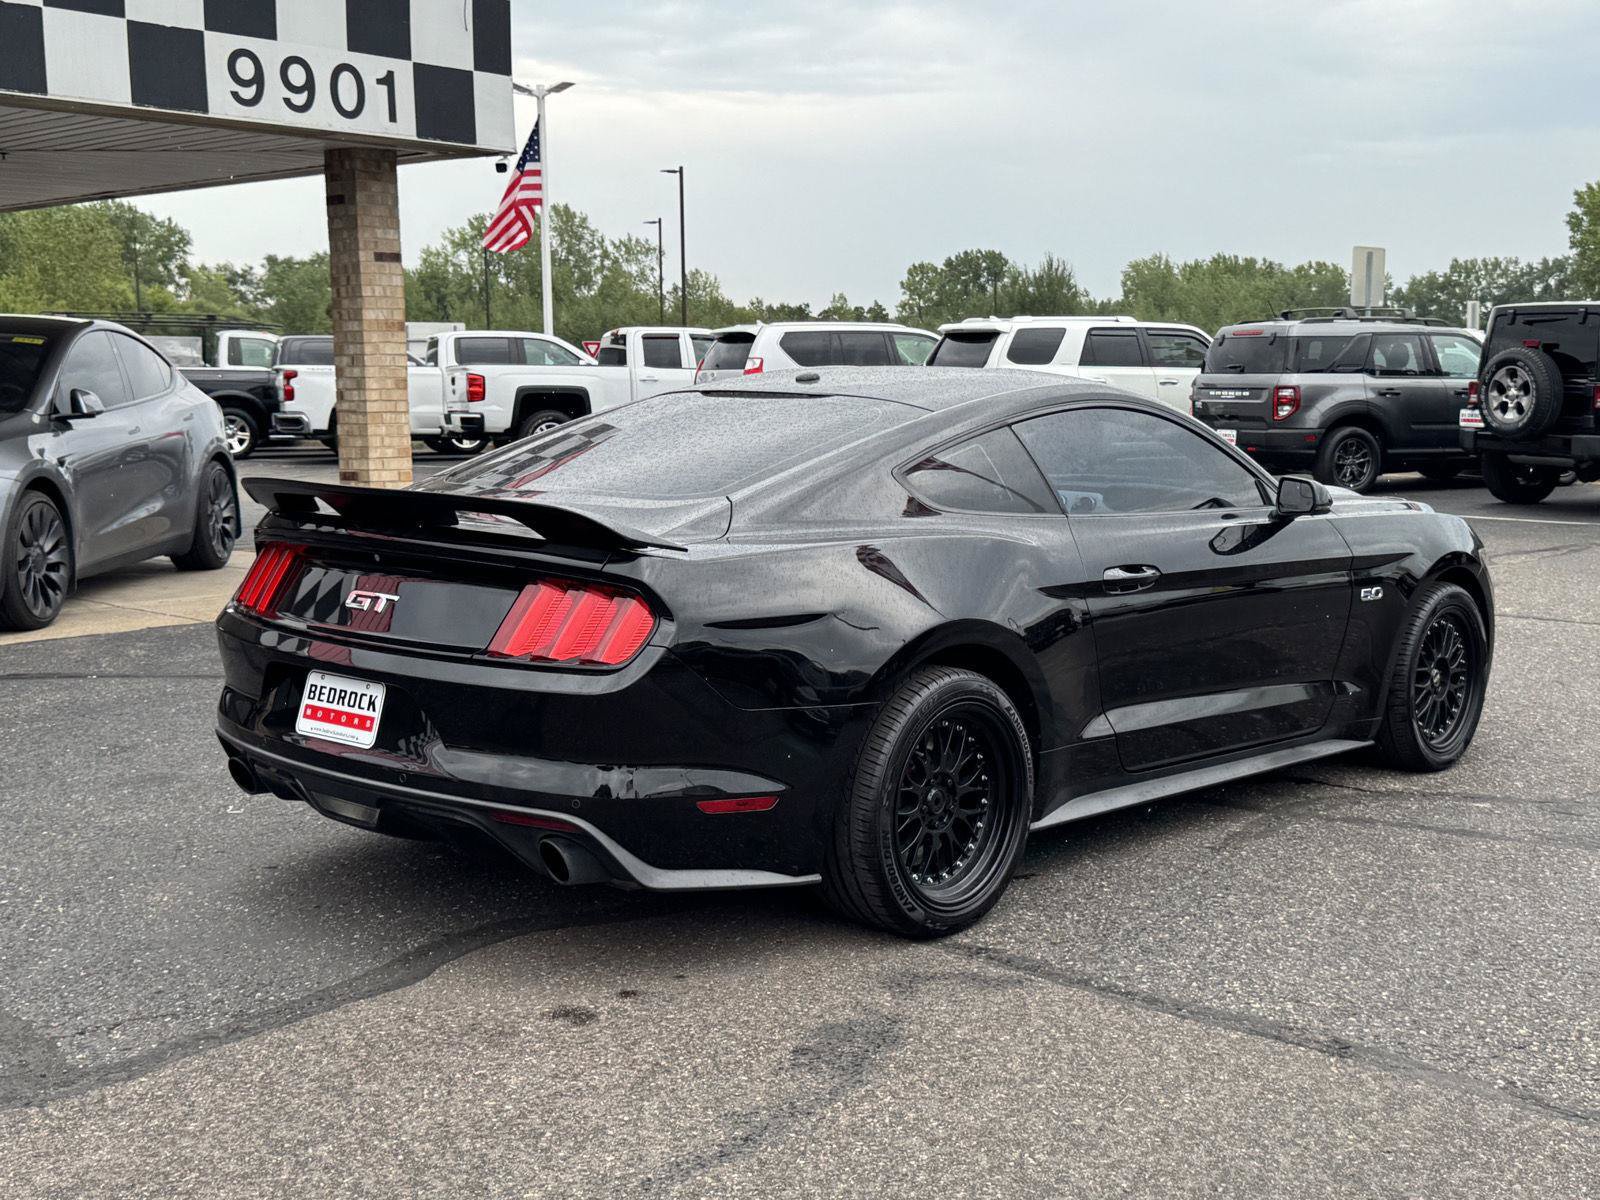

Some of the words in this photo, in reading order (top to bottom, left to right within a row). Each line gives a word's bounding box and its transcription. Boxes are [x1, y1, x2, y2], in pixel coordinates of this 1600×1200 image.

[227, 47, 398, 123] 9901
[345, 590, 400, 613] GT
[307, 684, 378, 712] BEDROCK
[305, 707, 372, 728] MOTORS
